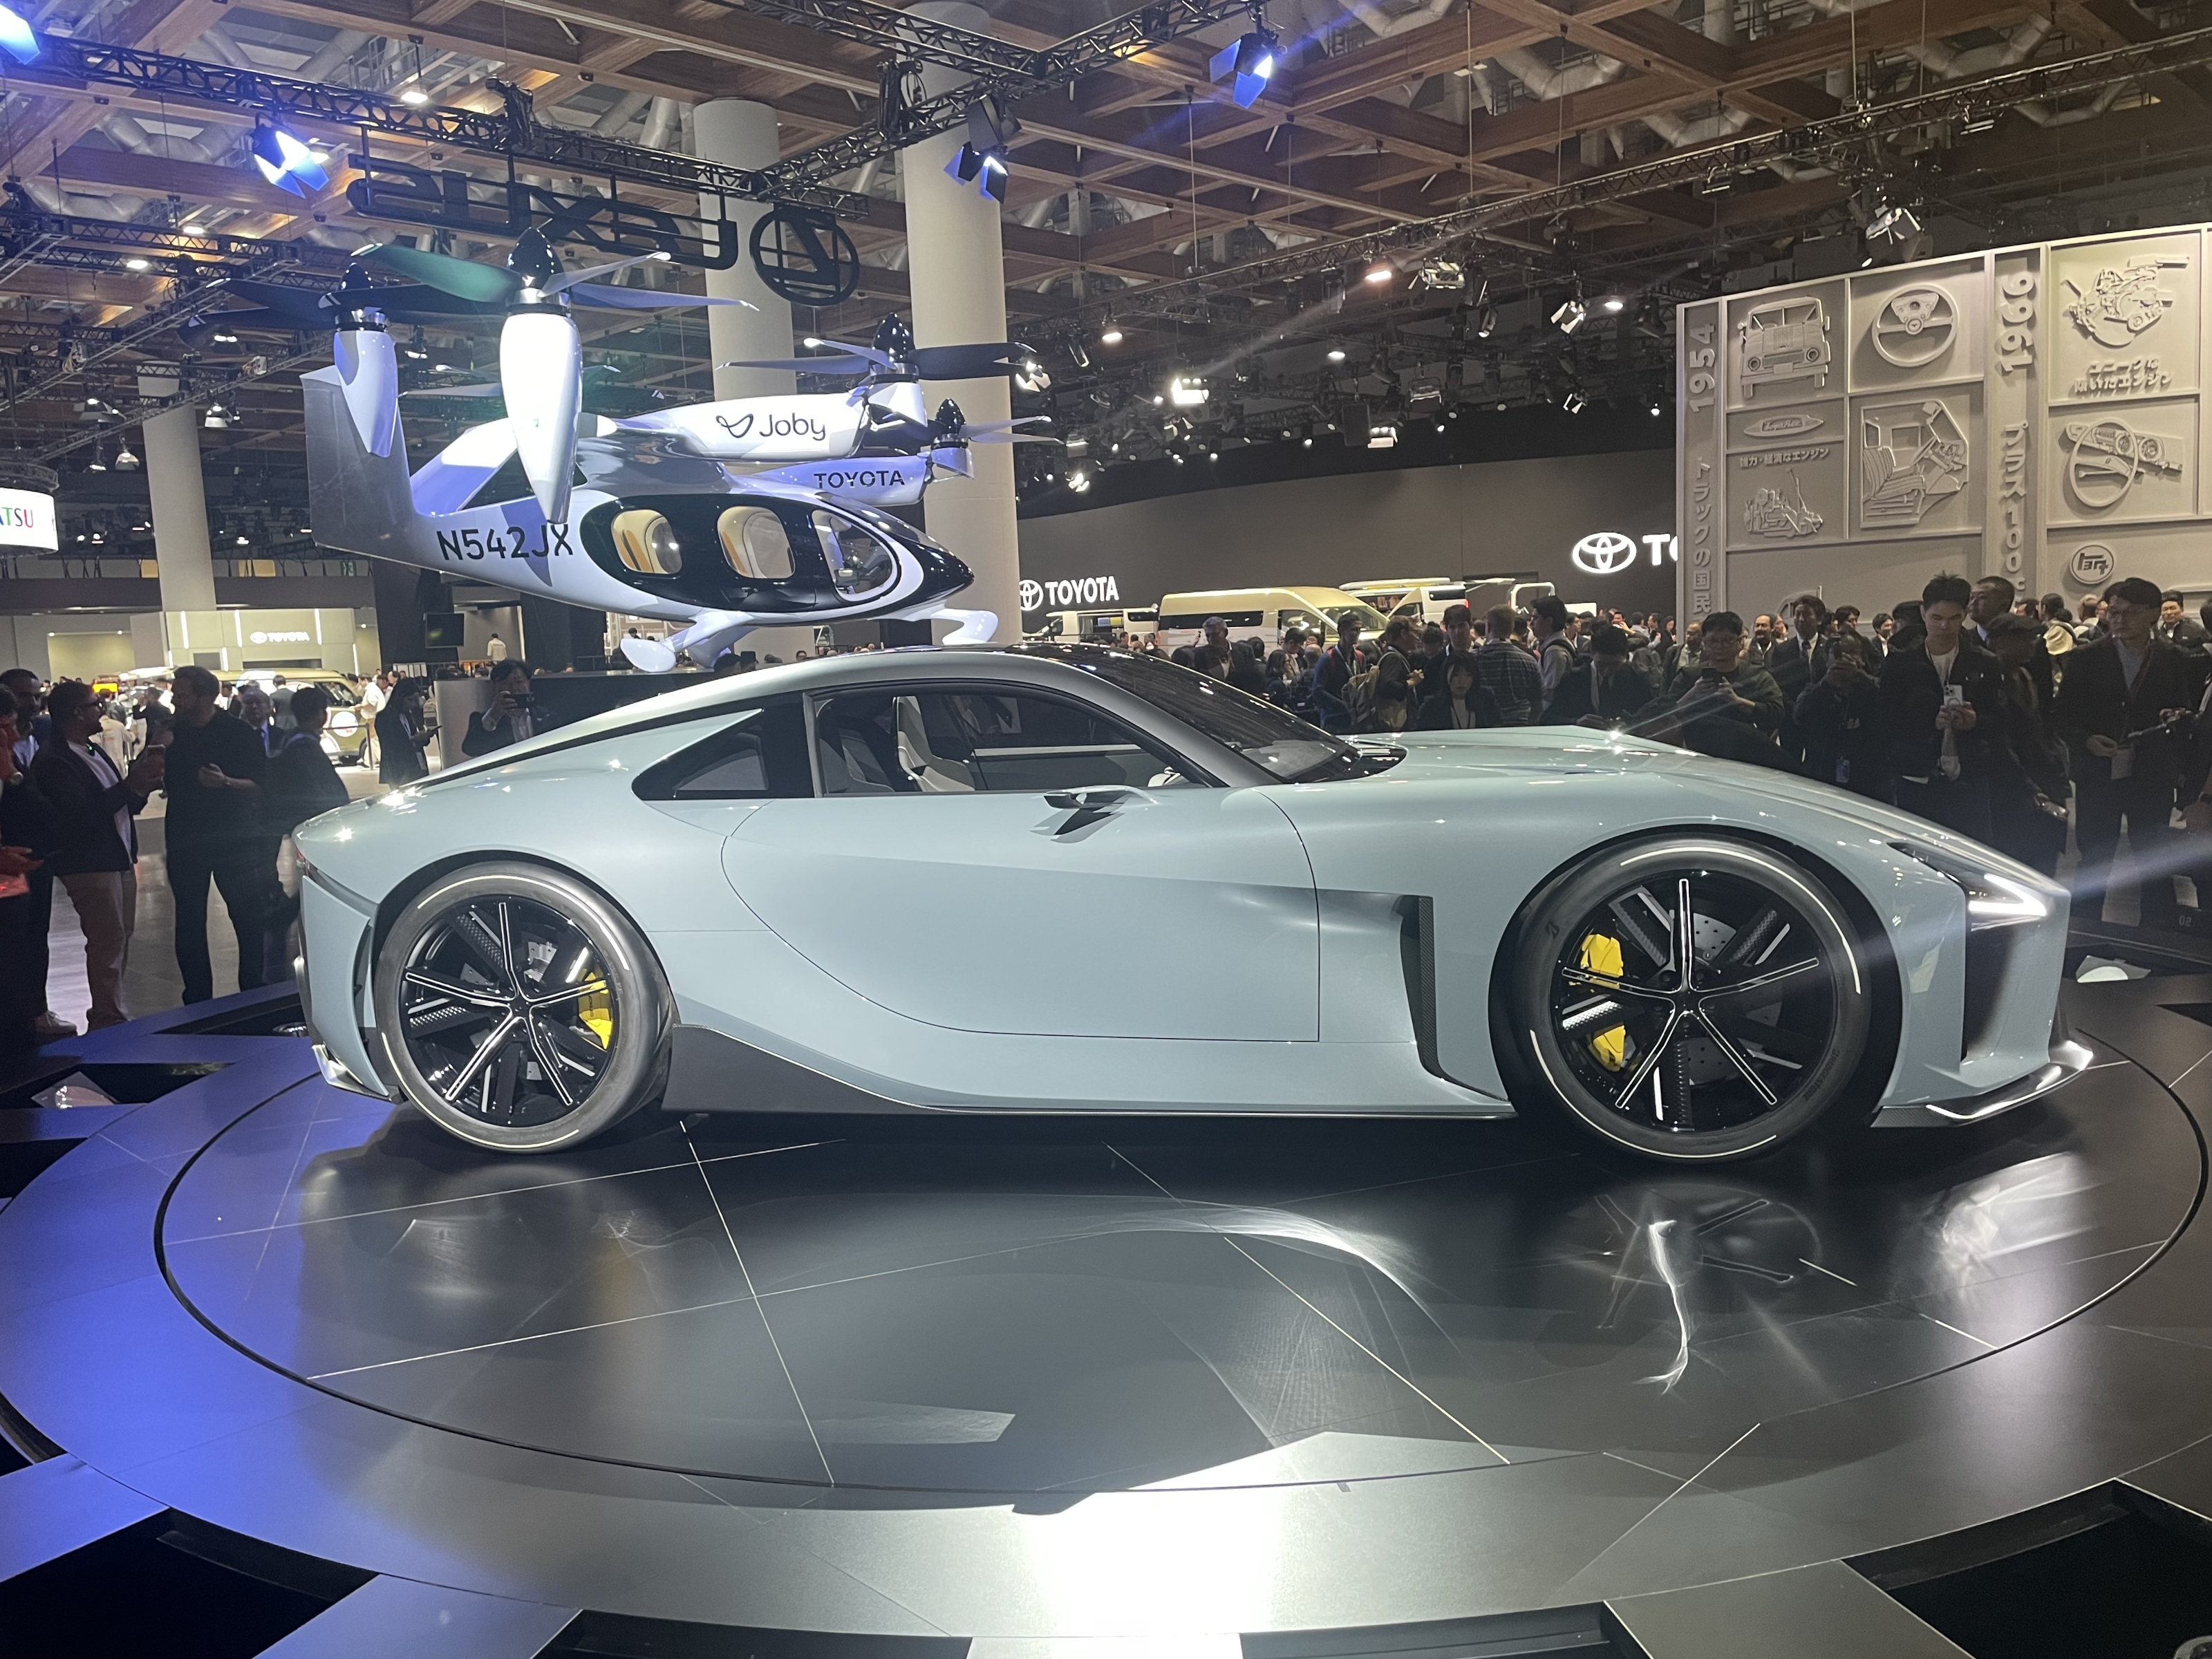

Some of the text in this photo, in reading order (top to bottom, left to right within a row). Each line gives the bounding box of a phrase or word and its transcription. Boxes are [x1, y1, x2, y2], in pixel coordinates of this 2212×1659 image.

[1999, 270, 2034, 372] 1966
[1689, 324, 1715, 413] 1954
[759, 413, 826, 441] Joby
[814, 470, 906, 489] TOYOTA
[436, 524, 574, 561] N542JX
[1694, 457, 1711, 621] トラックの国民
[1044, 576, 1119, 606] TOYOTA
[266, 632, 310, 643] TOYOTA
